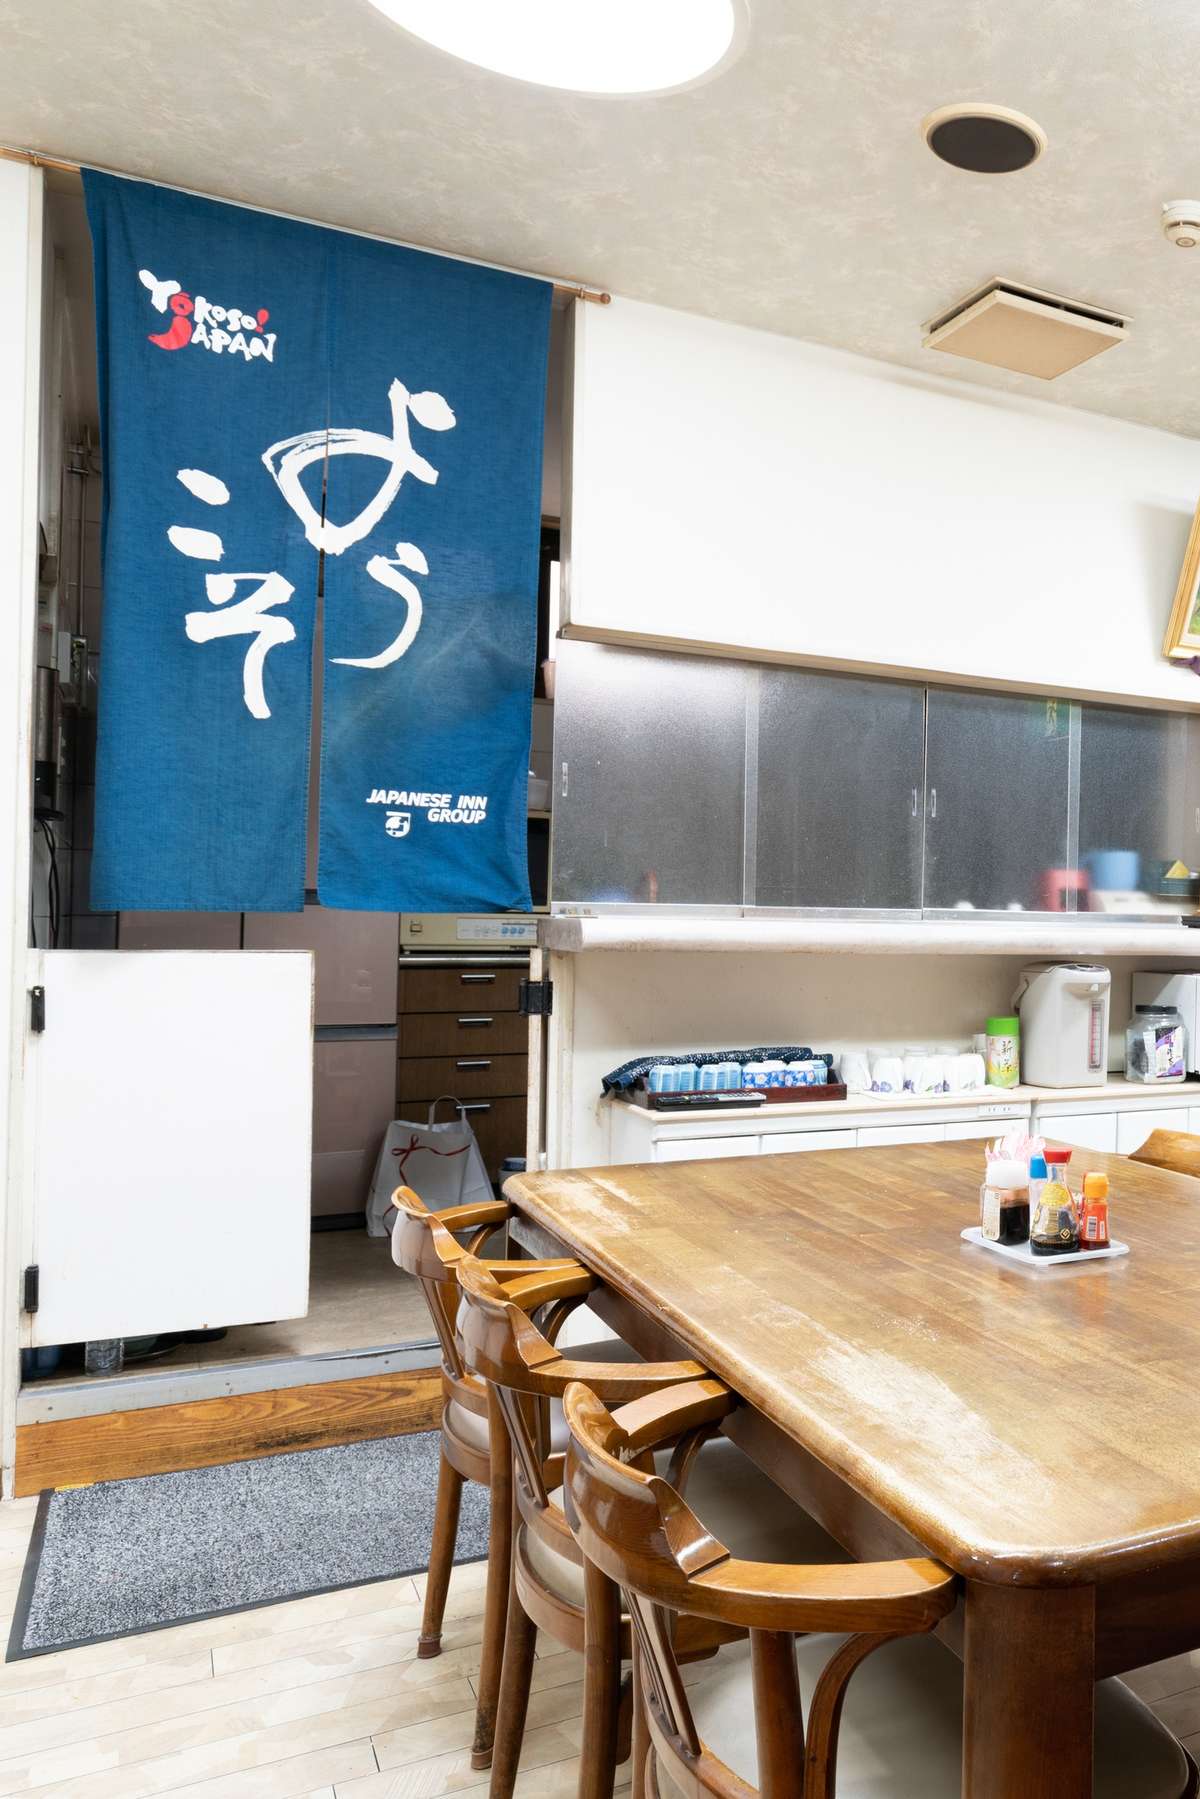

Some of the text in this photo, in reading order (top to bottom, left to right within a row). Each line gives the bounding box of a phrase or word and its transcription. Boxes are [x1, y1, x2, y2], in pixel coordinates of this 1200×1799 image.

[147, 315, 277, 363] JAPAN
[365, 788, 488, 810] JAPANESE INN
[427, 808, 487, 824] GROUP
